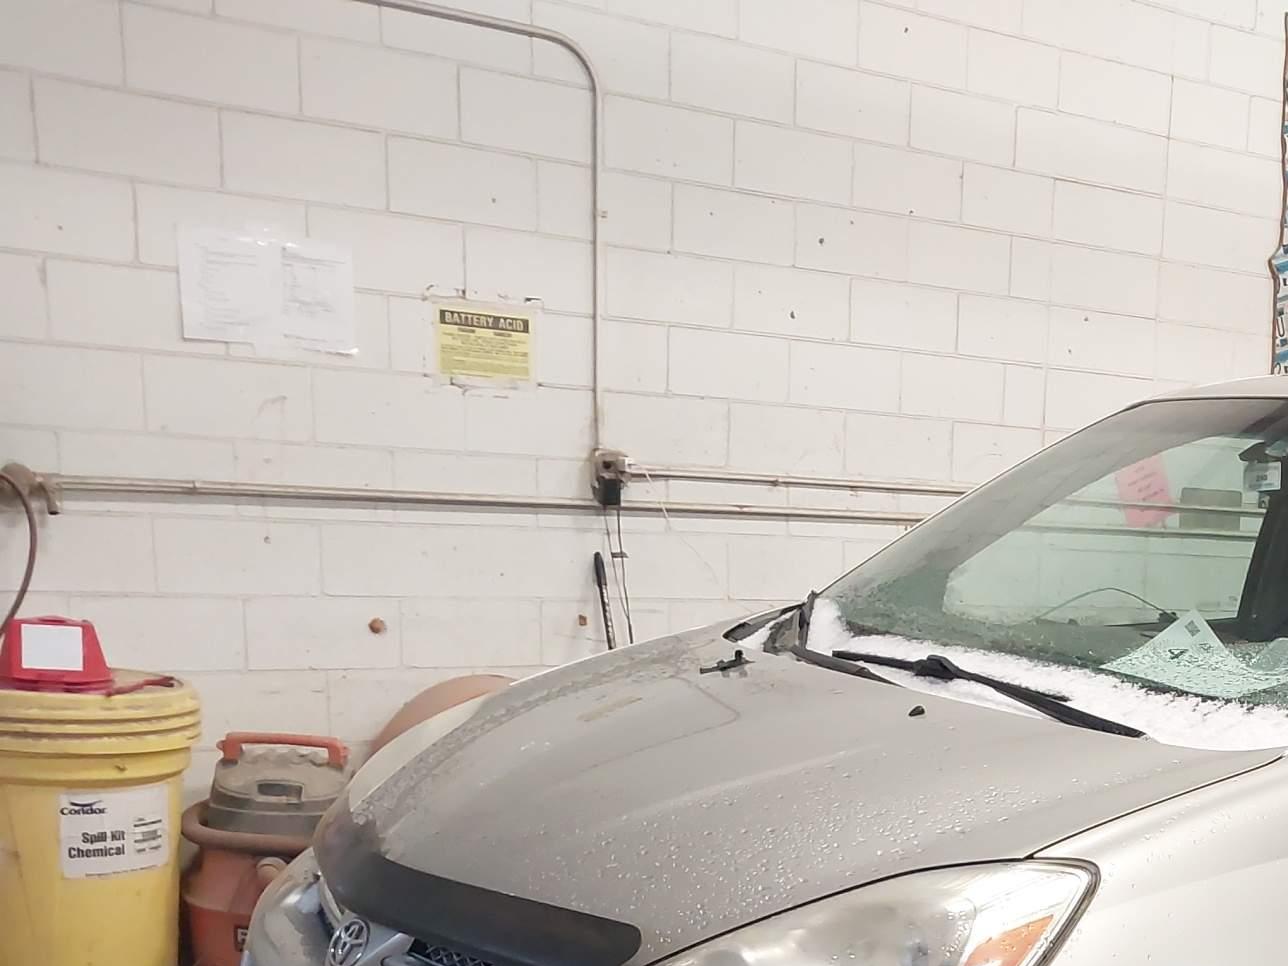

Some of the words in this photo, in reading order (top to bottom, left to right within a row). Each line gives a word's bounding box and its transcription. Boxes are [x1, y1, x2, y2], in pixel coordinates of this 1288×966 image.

[444, 311, 494, 328] BATTERY
[498, 318, 525, 331] ACID
[59, 806, 107, 816] Condor
[81, 831, 107, 845] Spill
[110, 830, 125, 842] Kit
[67, 844, 125, 859] Chemical
